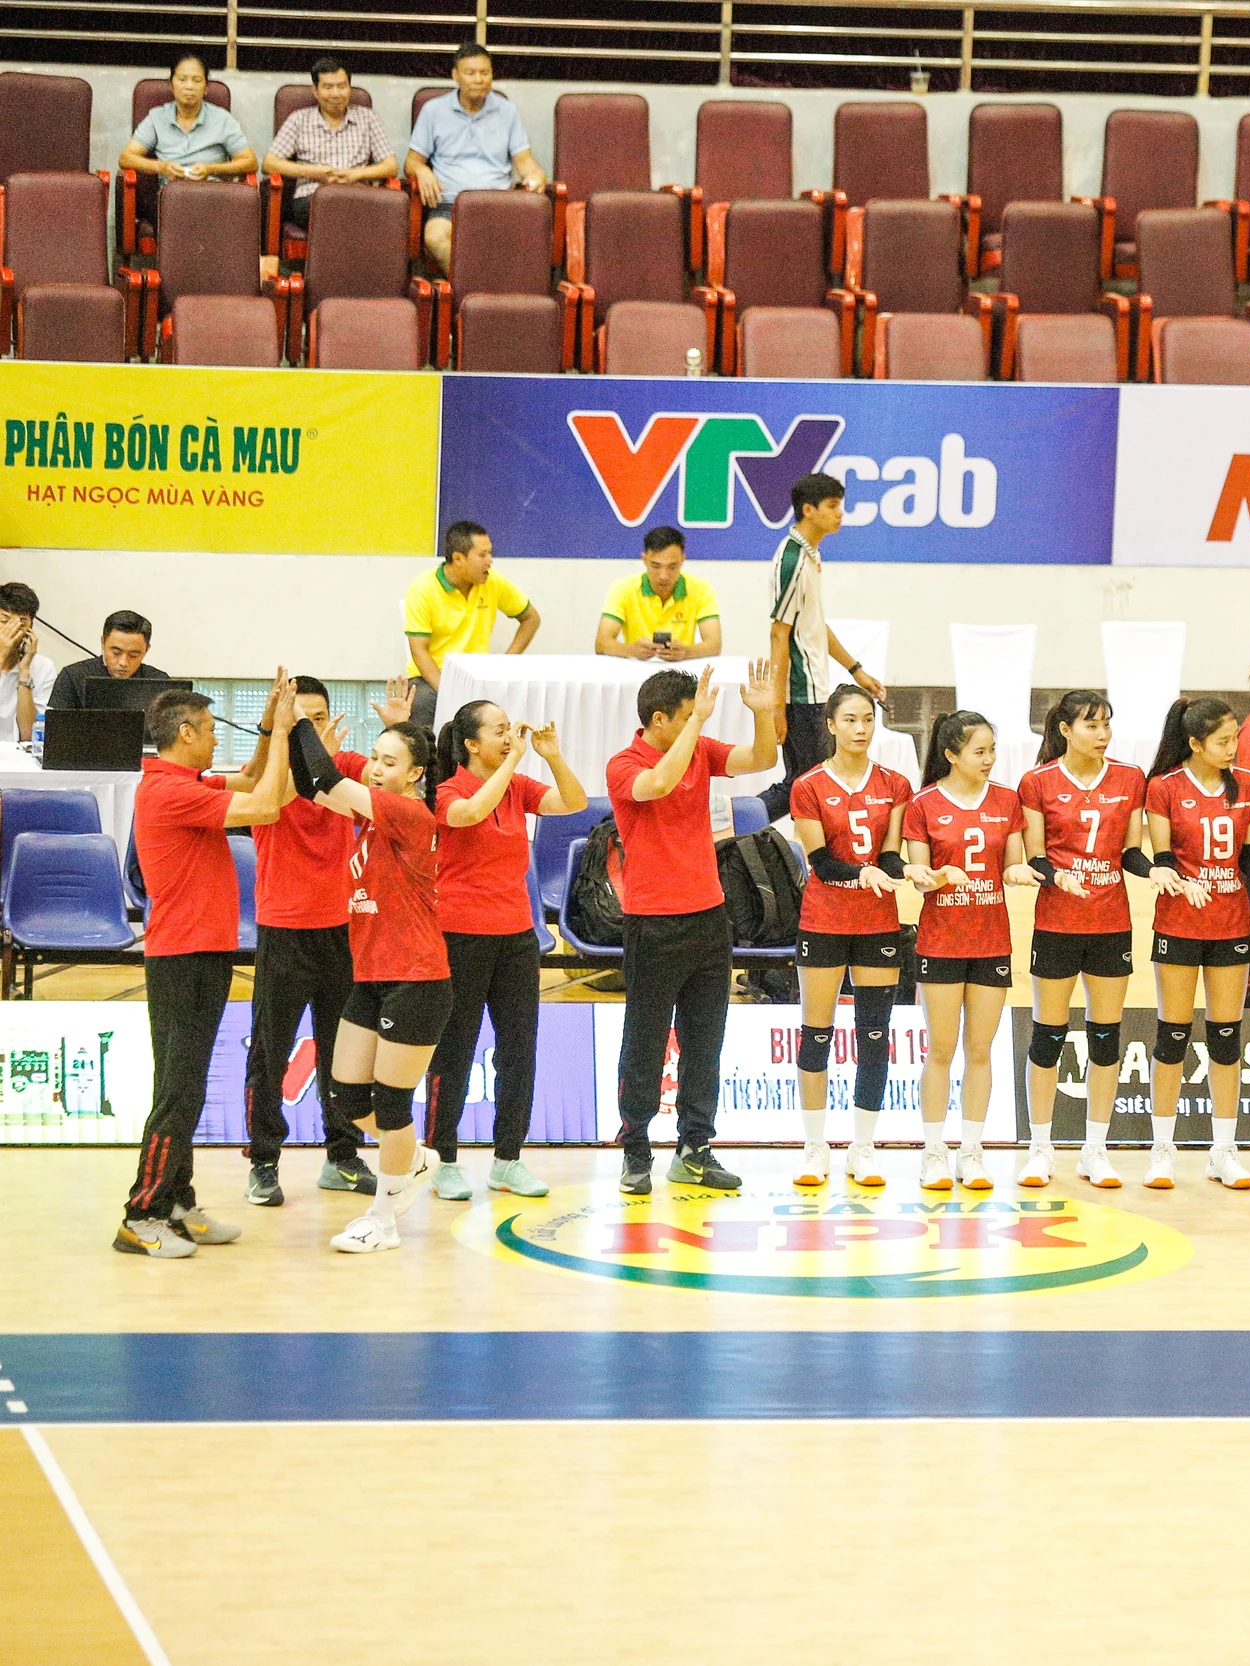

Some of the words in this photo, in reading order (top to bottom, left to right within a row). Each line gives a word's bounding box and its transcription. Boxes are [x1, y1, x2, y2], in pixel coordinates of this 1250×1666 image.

[5, 411, 94, 469] PHÂN
[104, 414, 171, 472] BÓN
[180, 417, 222, 473] CÀ
[233, 426, 302, 475] MAU
[27, 484, 71, 505] HẠT
[73, 486, 141, 510] NGỌC
[147, 483, 194, 508] MÙA
[201, 484, 265, 509] VÀNG
[848, 809, 873, 855] 5
[963, 827, 986, 872] 2
[1079, 809, 1101, 853] 7
[1199, 816, 1235, 861] 19
[801, 941, 809, 957] 5
[1158, 938, 1168, 955] 19
[921, 959, 928, 974] 2
[896, 1200, 1068, 1215] MAU
[601, 1216, 1087, 1254] NPK
